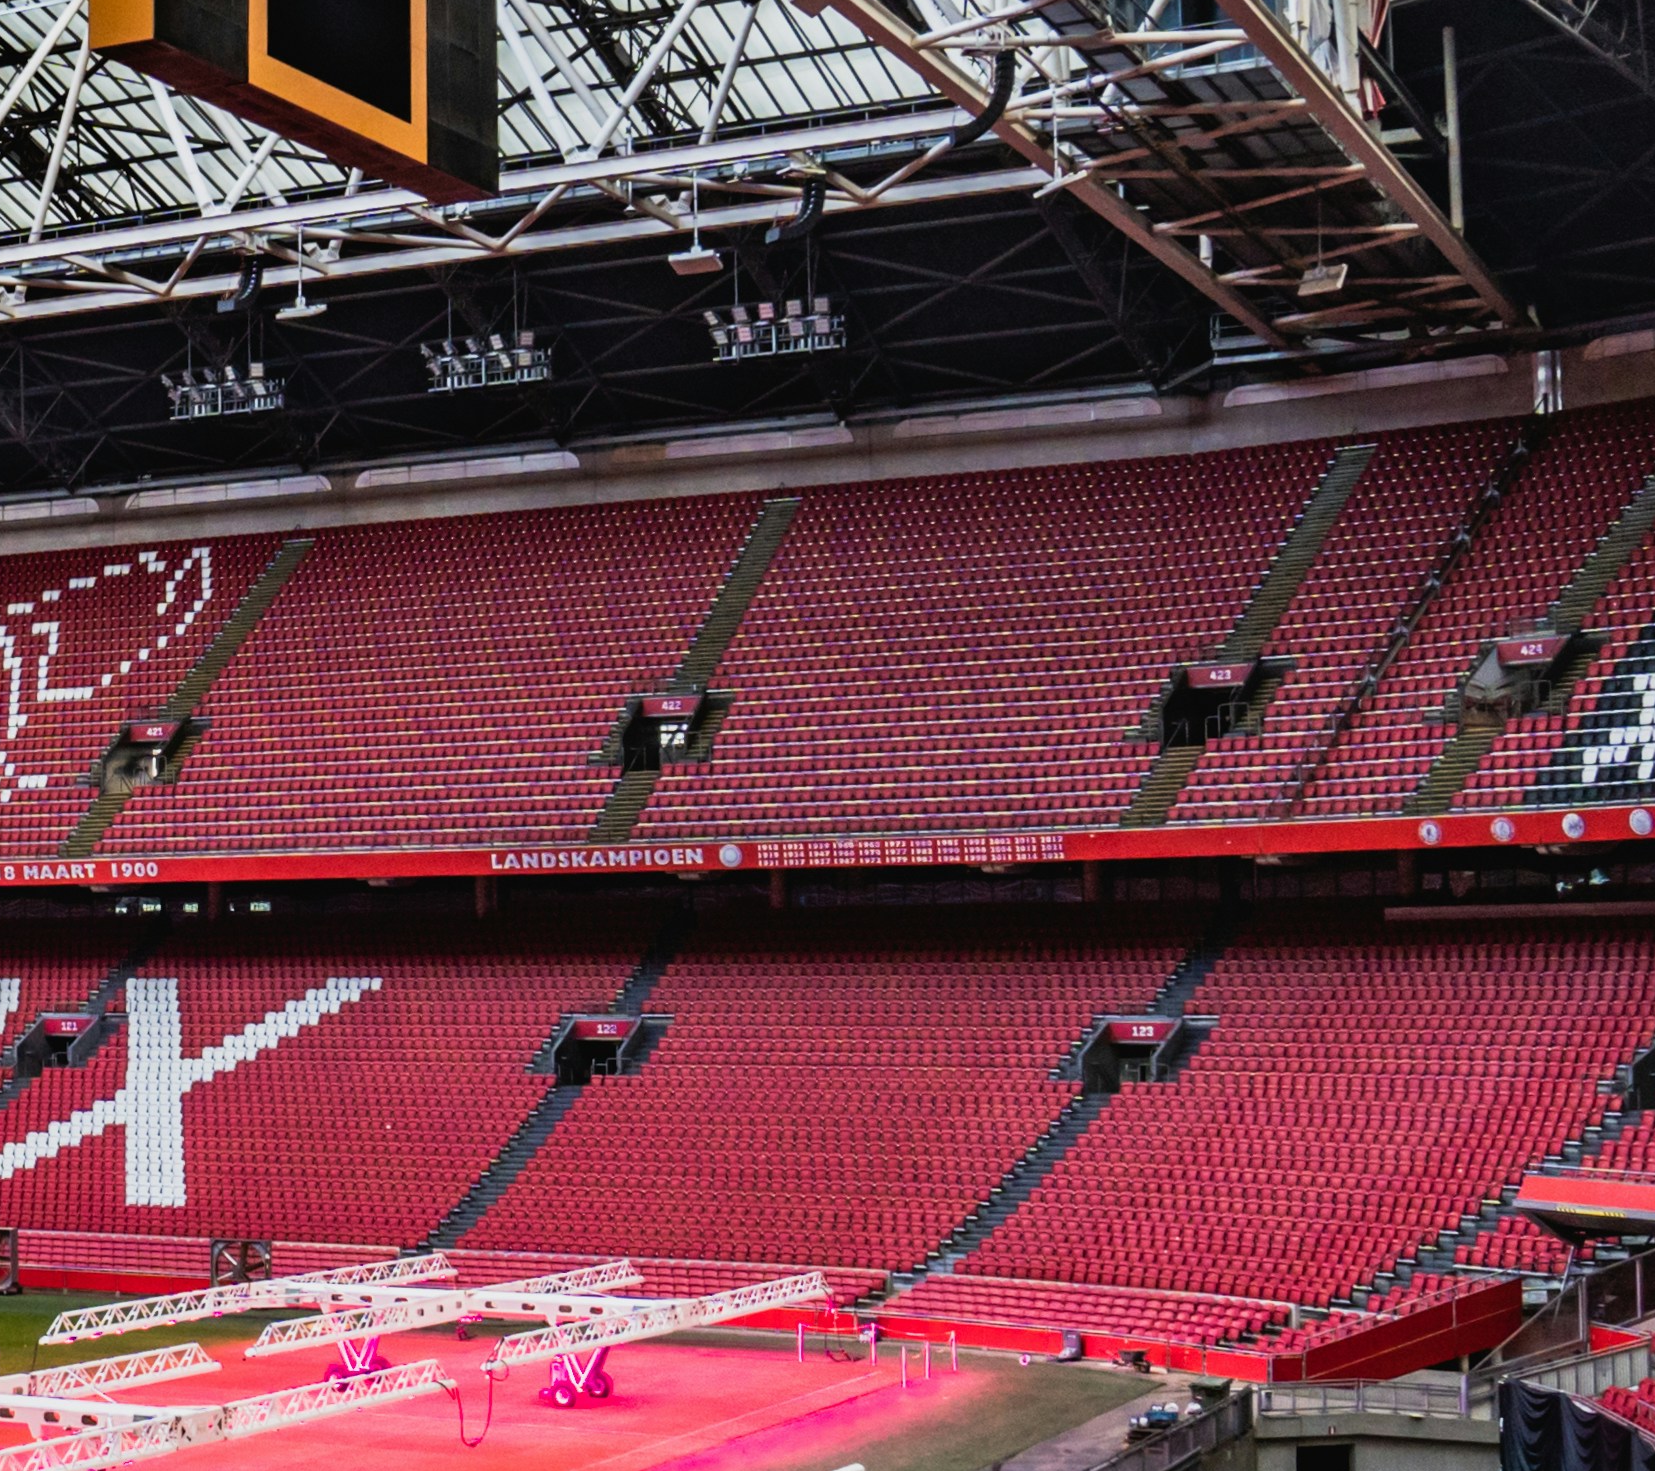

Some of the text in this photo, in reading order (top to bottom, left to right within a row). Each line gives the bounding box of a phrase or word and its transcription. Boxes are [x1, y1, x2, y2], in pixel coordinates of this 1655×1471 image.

[1520, 644, 1543, 655] 424
[1210, 670, 1231, 680] 423
[661, 700, 682, 710] 422
[146, 728, 163, 736] 421
[491, 848, 703, 869] LANDSKAMPIOEN
[23, 863, 96, 879] MAART
[111, 862, 159, 878] 1900
[597, 1024, 617, 1034] 122
[1132, 1026, 1154, 1037] 123
